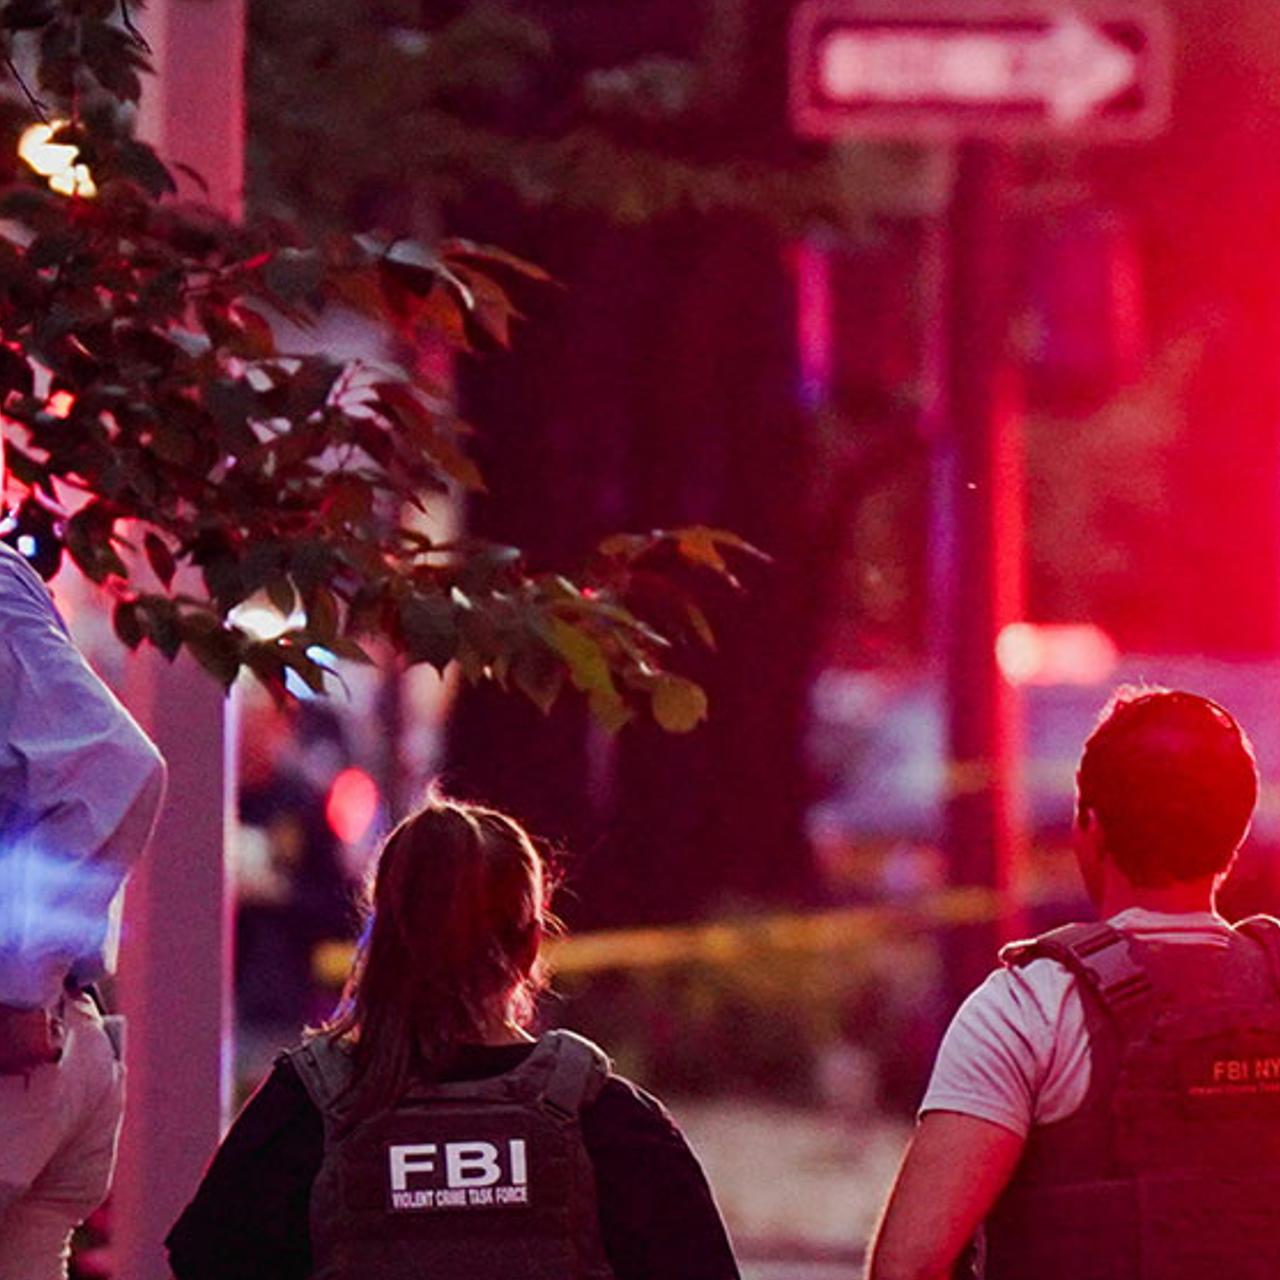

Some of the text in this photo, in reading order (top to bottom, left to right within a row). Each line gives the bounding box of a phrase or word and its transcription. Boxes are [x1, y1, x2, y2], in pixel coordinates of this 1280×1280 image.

[1213, 1060, 1249, 1081] FBI
[389, 1139, 528, 1190] FBI
[392, 1186, 528, 1209] VIOLENT CRIME TASK FORCE
